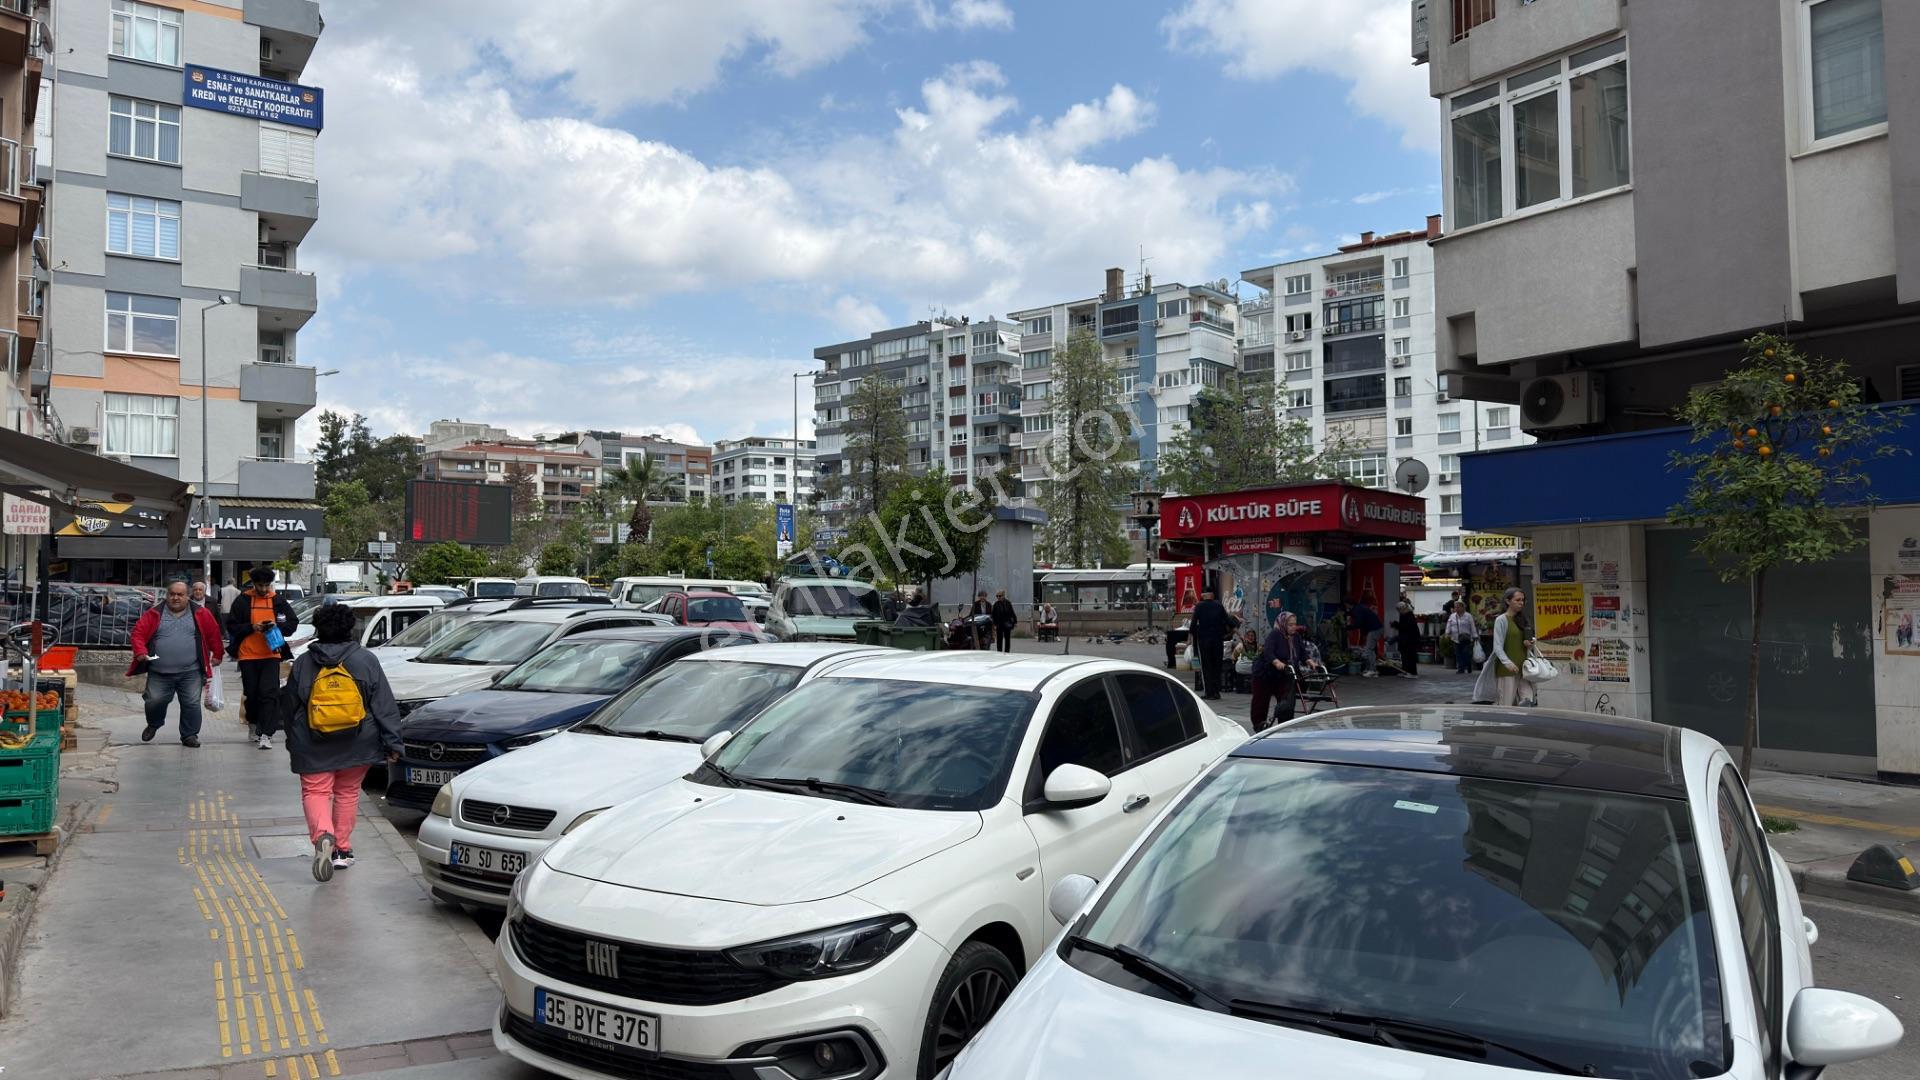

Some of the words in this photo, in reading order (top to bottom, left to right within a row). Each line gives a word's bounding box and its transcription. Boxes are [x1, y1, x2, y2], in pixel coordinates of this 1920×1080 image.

[206, 79, 233, 92] ESNAF
[234, 85, 244, 95] ve
[245, 87, 301, 106] SANATKARLAR
[249, 79, 292, 92] KARABAĞLAR
[191, 87, 216, 102] KREDİ
[218, 94, 228, 104] ve
[229, 95, 263, 110] KEFALET
[264, 102, 314, 119] KOOPERATİFİ
[228, 105, 245, 114] 0232
[11, 504, 47, 514] GARAJ
[1207, 502, 1272, 522] KÜLTÜR
[1275, 498, 1322, 518] BÜFE
[1363, 502, 1401, 523] KÜLTÜR
[1401, 508, 1426, 526] BÜFE
[211, 514, 261, 531] HALİT
[265, 519, 307, 532] USTA
[412, 769, 422, 782] 35
[457, 846, 471, 865] 26
[479, 850, 492, 868] SD
[501, 854, 523, 873] 653
[585, 940, 620, 979] FIAT
[546, 997, 566, 1025] 35
[575, 1004, 607, 1037] BYE
[613, 1014, 649, 1047] 376
